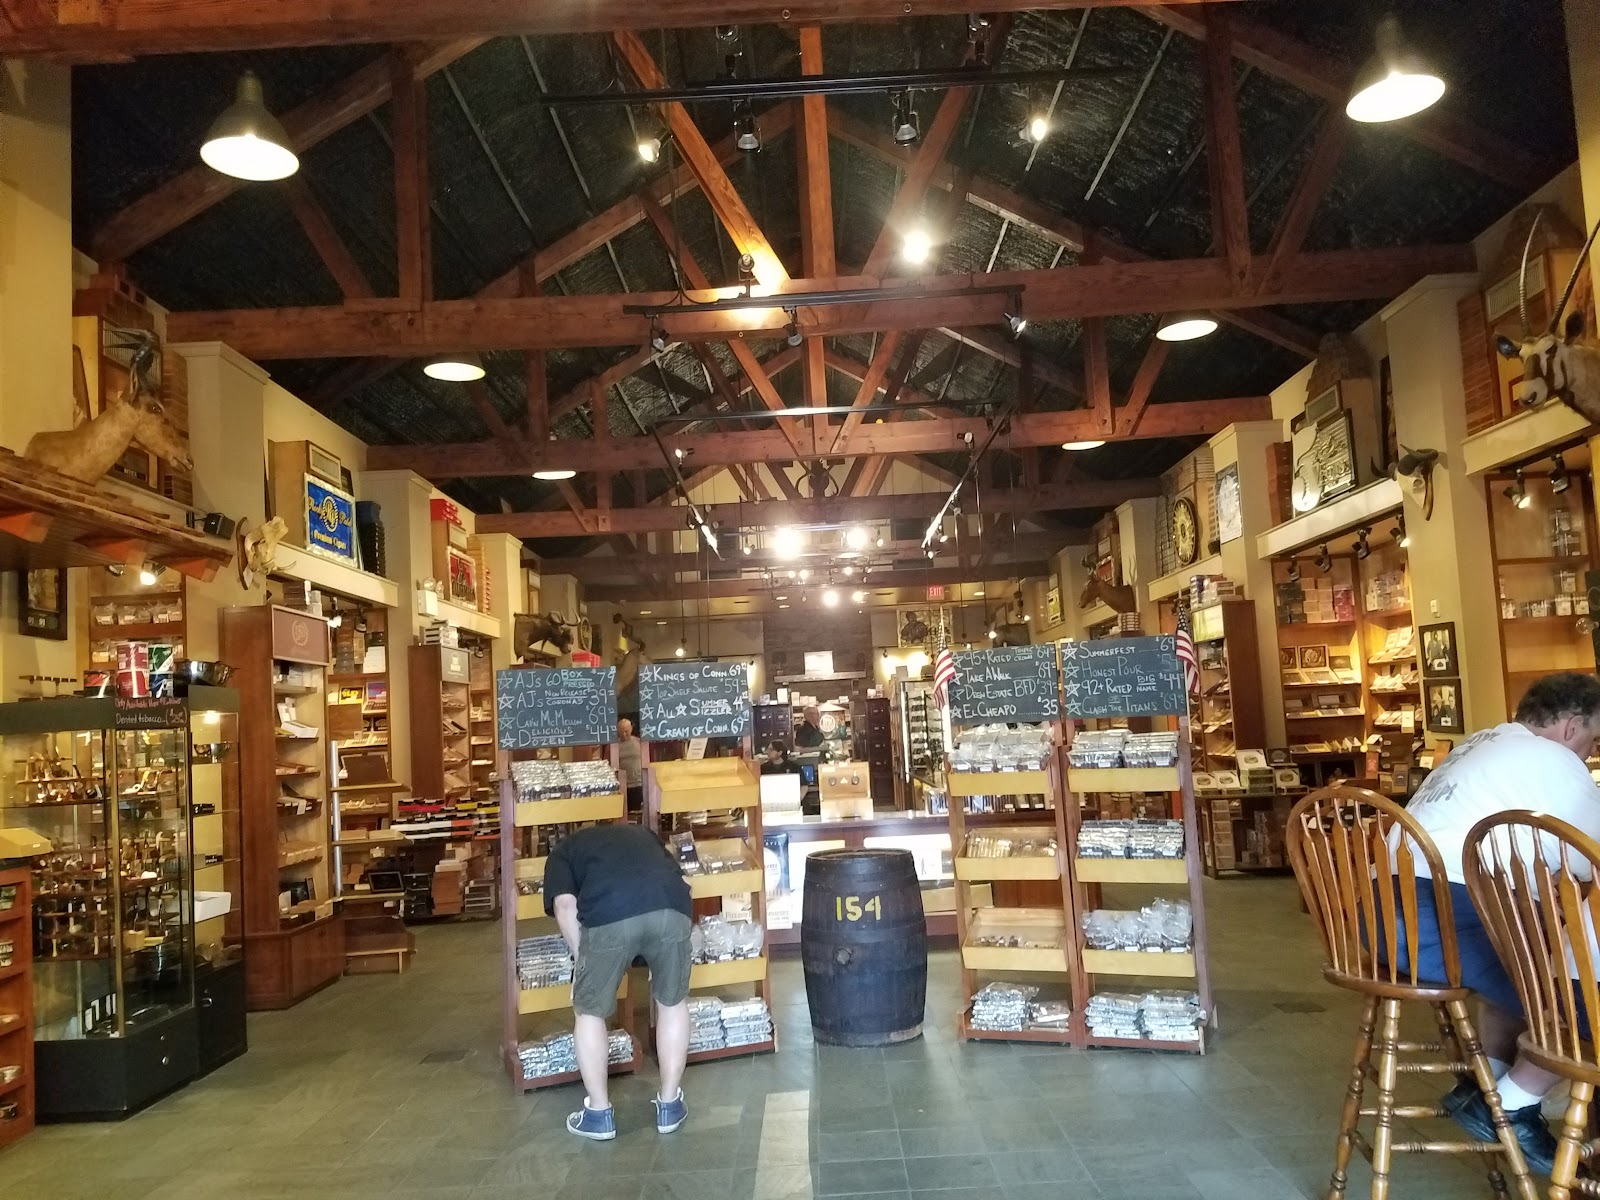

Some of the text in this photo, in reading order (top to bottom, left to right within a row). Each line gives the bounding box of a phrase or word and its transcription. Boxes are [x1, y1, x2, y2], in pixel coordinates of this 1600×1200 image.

[930, 587, 942, 597] EXIT
[653, 665, 685, 682] KINGS
[962, 667, 984, 684] TAKE
[1081, 660, 1117, 678] HONEST
[1117, 656, 1145, 676] POUR
[545, 672, 561, 687] 60
[1106, 678, 1132, 694] RATED
[1137, 674, 1156, 683] BIG
[692, 681, 718, 694] SALUTE
[1013, 679, 1036, 697] BFD
[1082, 696, 1107, 714] CLASH
[1121, 694, 1158, 713] TITANS
[657, 720, 690, 738] CREAM
[691, 727, 705, 736] OF
[836, 896, 881, 922] 154
